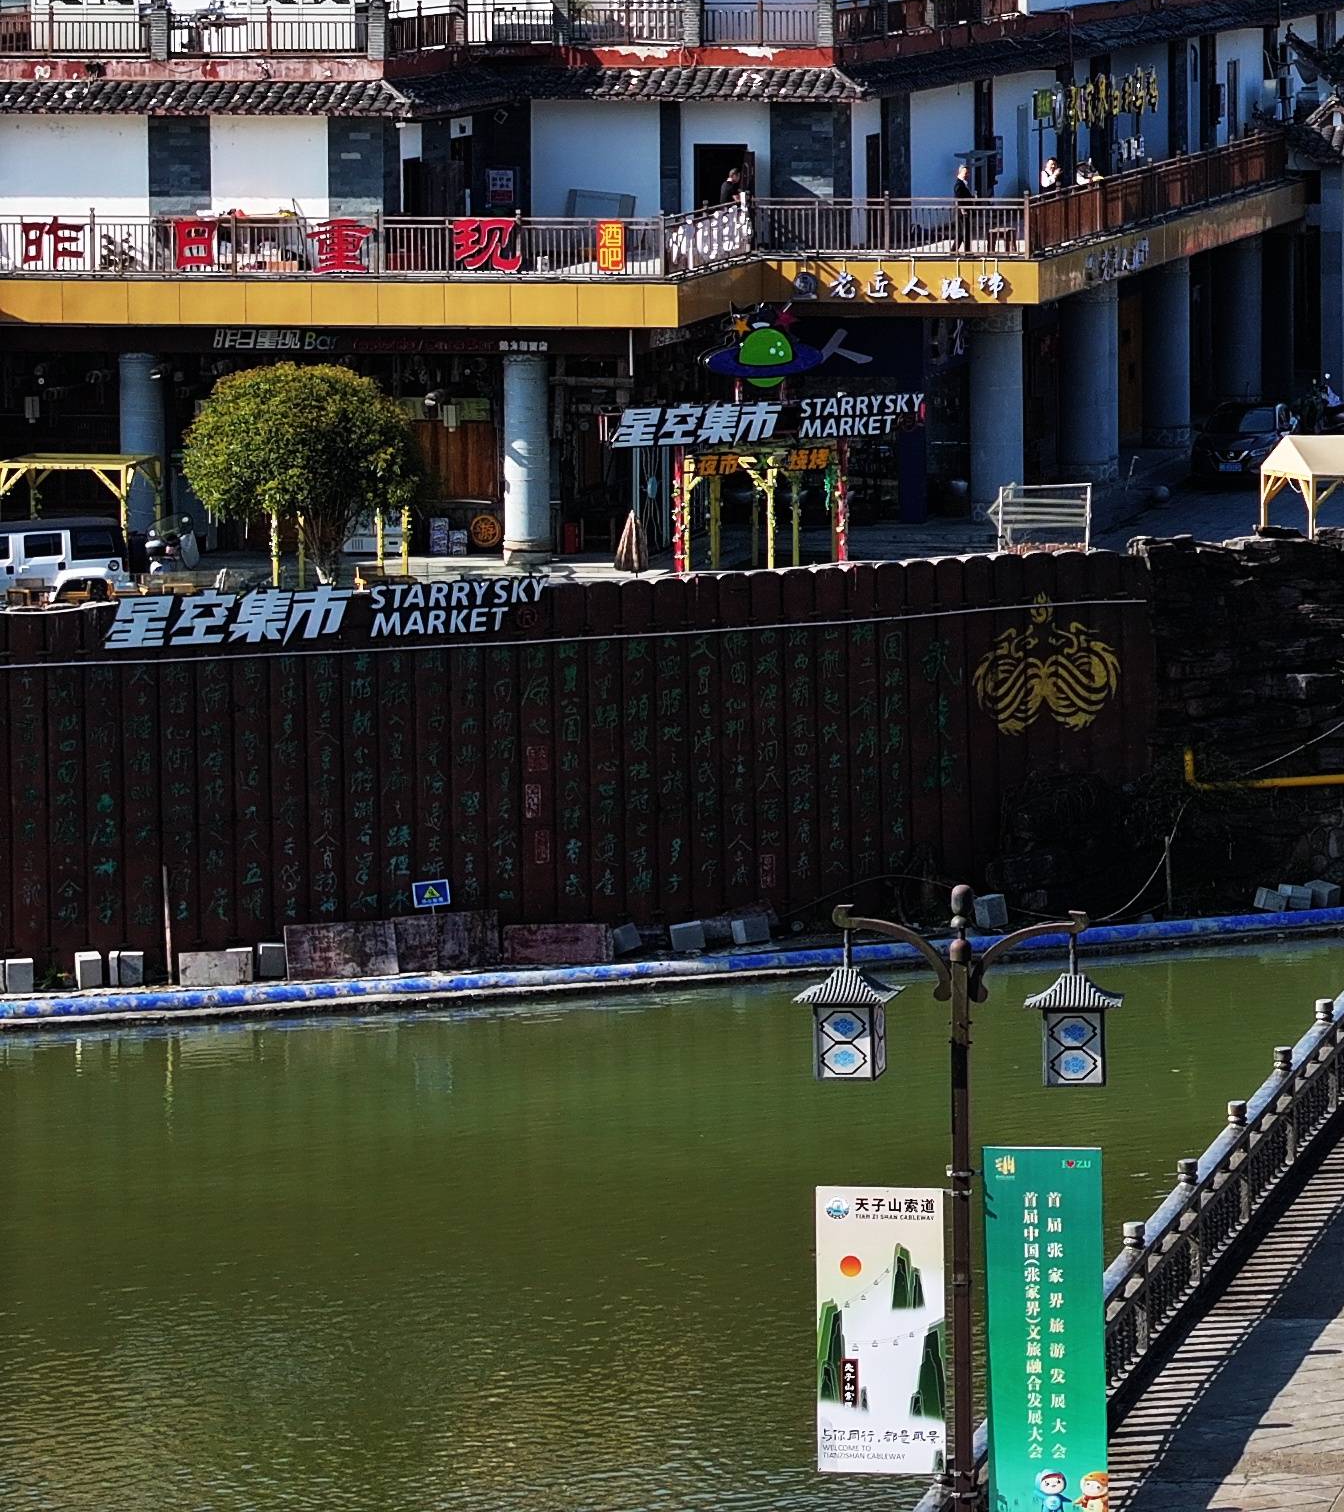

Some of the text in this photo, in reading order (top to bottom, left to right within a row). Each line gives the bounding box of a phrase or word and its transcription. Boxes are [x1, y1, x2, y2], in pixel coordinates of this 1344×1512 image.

[20, 218, 522, 275] 昨日重现
[599, 223, 623, 270] 酒吧
[213, 329, 300, 349] 昨日重现
[304, 331, 337, 350] Bar
[611, 401, 783, 449] 星空集市
[800, 414, 897, 438] MARKET
[697, 454, 740, 477] 夜市
[105, 587, 353, 650] 星空集市
[370, 606, 510, 638] MARKET
[855, 1197, 935, 1214] 天子山索道
[1047, 1191, 1067, 1460] 首届张家界旅游发展大会
